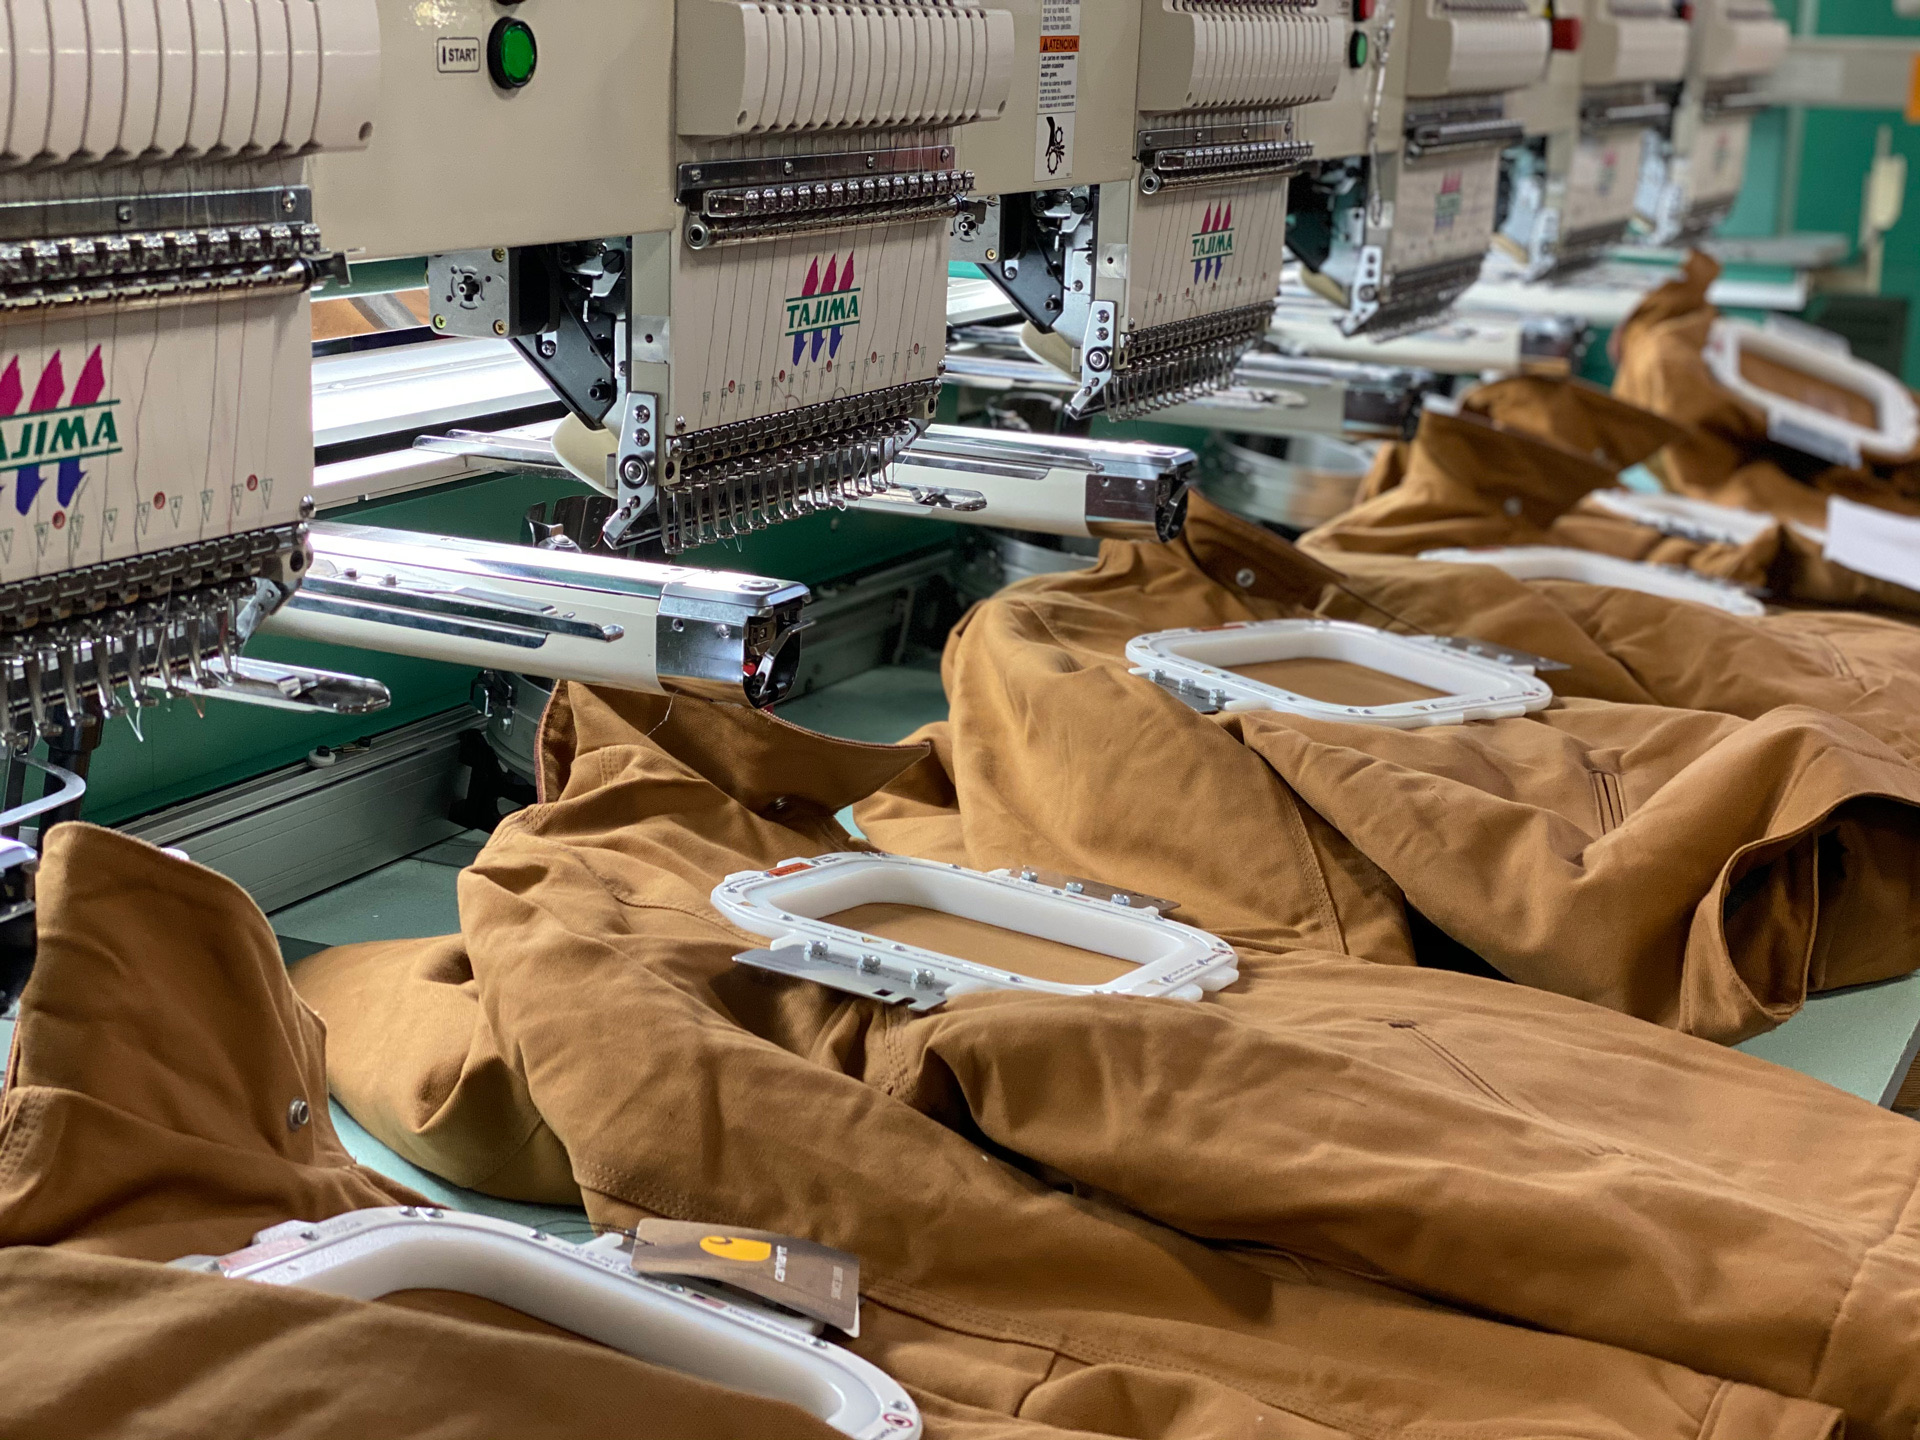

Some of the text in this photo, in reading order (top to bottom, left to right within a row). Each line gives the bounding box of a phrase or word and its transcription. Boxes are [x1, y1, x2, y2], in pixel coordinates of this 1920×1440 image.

[448, 48, 477, 62] START
[1192, 233, 1232, 257] TAJIMA
[786, 295, 859, 328] TAJIMA
